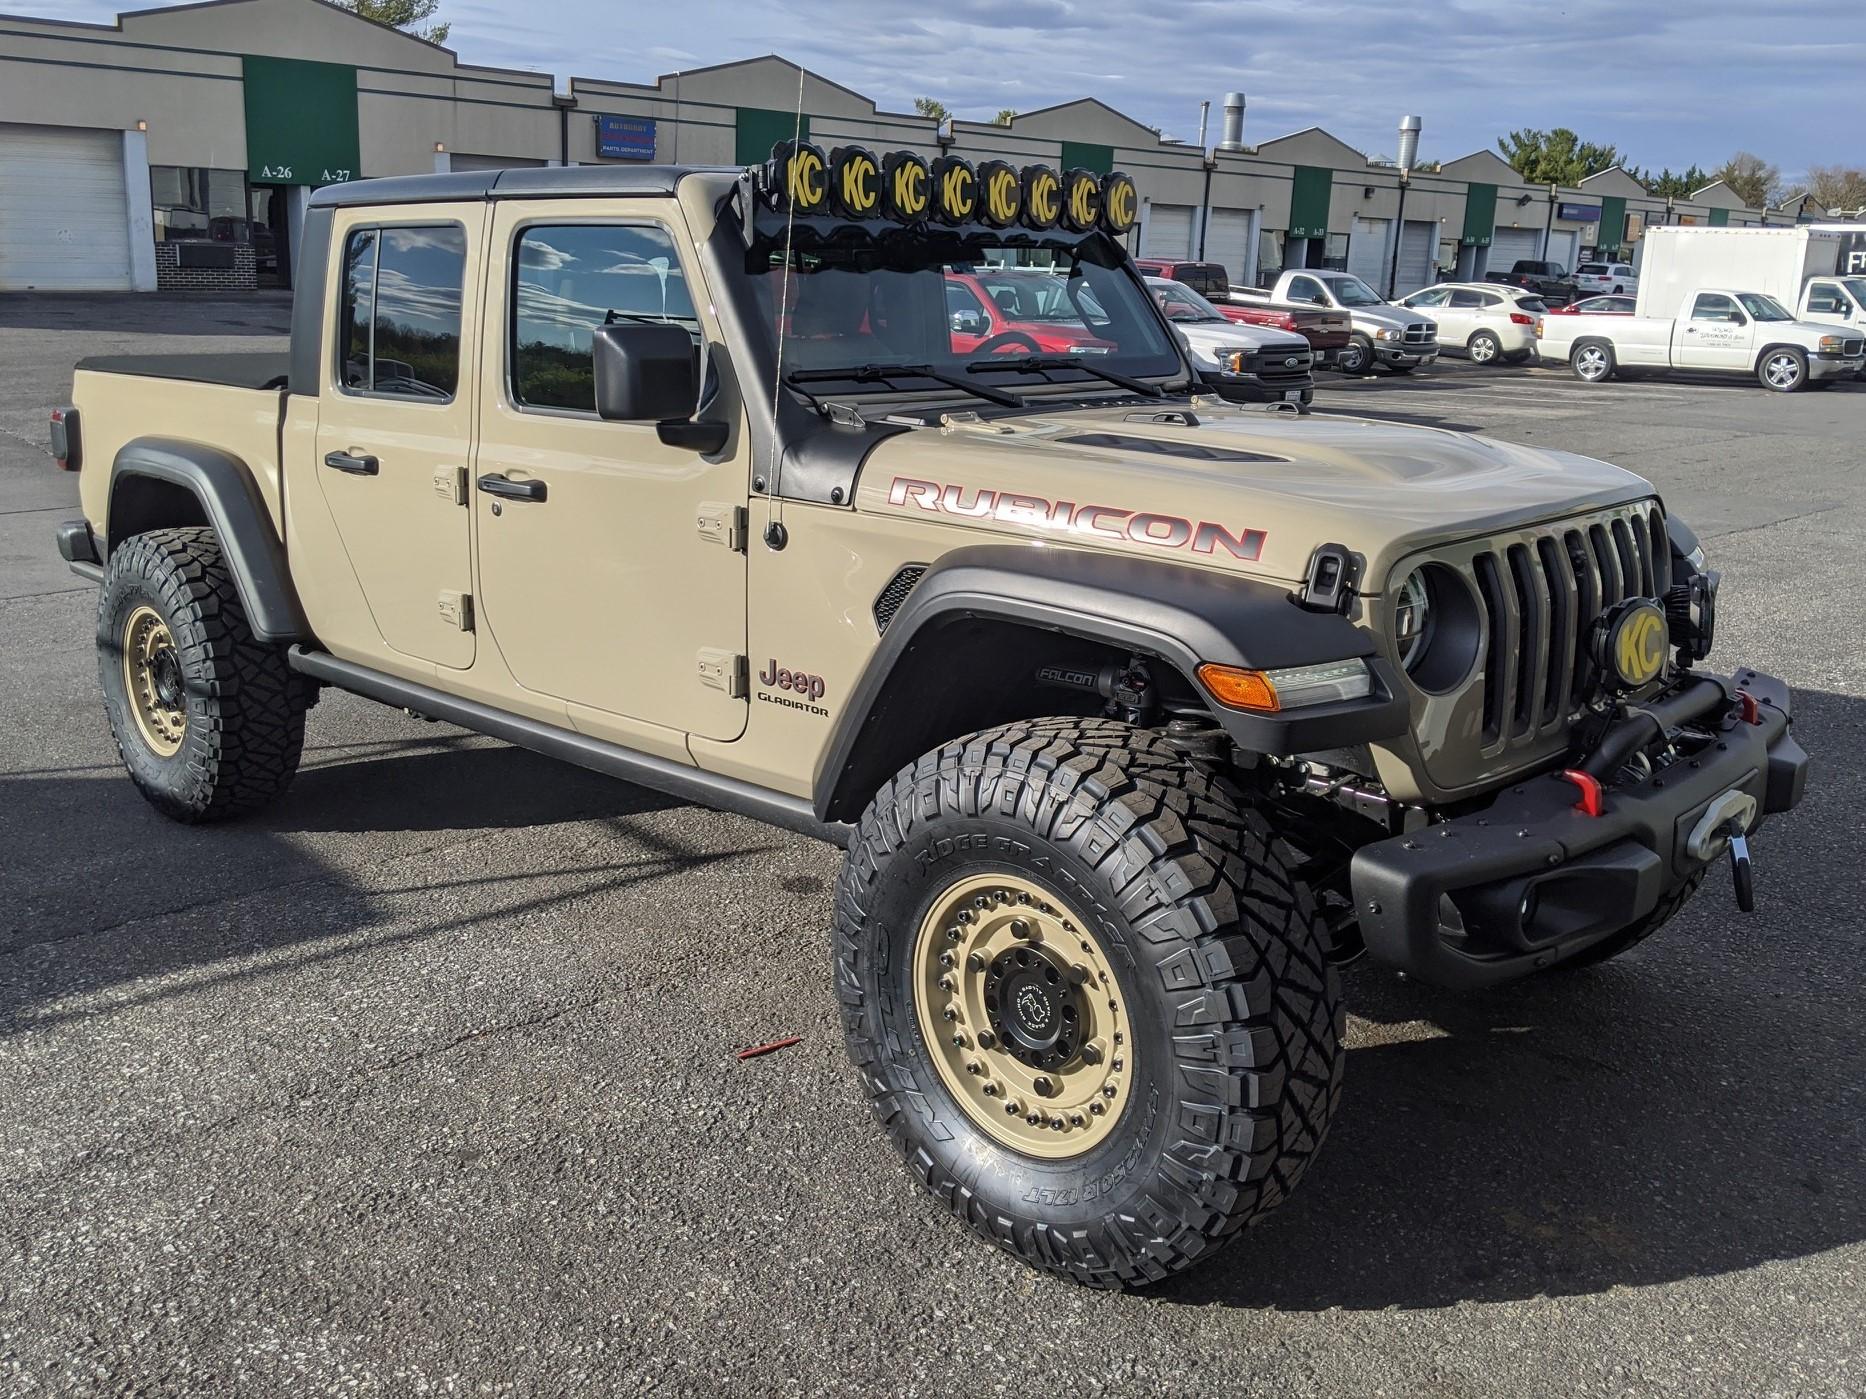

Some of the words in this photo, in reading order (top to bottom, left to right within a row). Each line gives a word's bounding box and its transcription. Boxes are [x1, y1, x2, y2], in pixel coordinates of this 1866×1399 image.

[261, 165, 292, 179] A-26
[321, 168, 350, 182] A-27
[787, 151, 822, 207] KC
[843, 156, 876, 211] KC
[895, 161, 925, 214] KC
[943, 165, 972, 217] KC
[989, 170, 1016, 220] KC
[1032, 174, 1057, 222] KC
[1072, 177, 1096, 225] KC
[1110, 181, 1133, 226] KC
[887, 476, 1268, 562] RUBICON
[1621, 612, 1662, 679] KC
[758, 658, 826, 702] Jeep
[1040, 668, 1094, 687] FALCON
[757, 692, 829, 718] GLADIATOR
[914, 833, 988, 877] RIDGE
